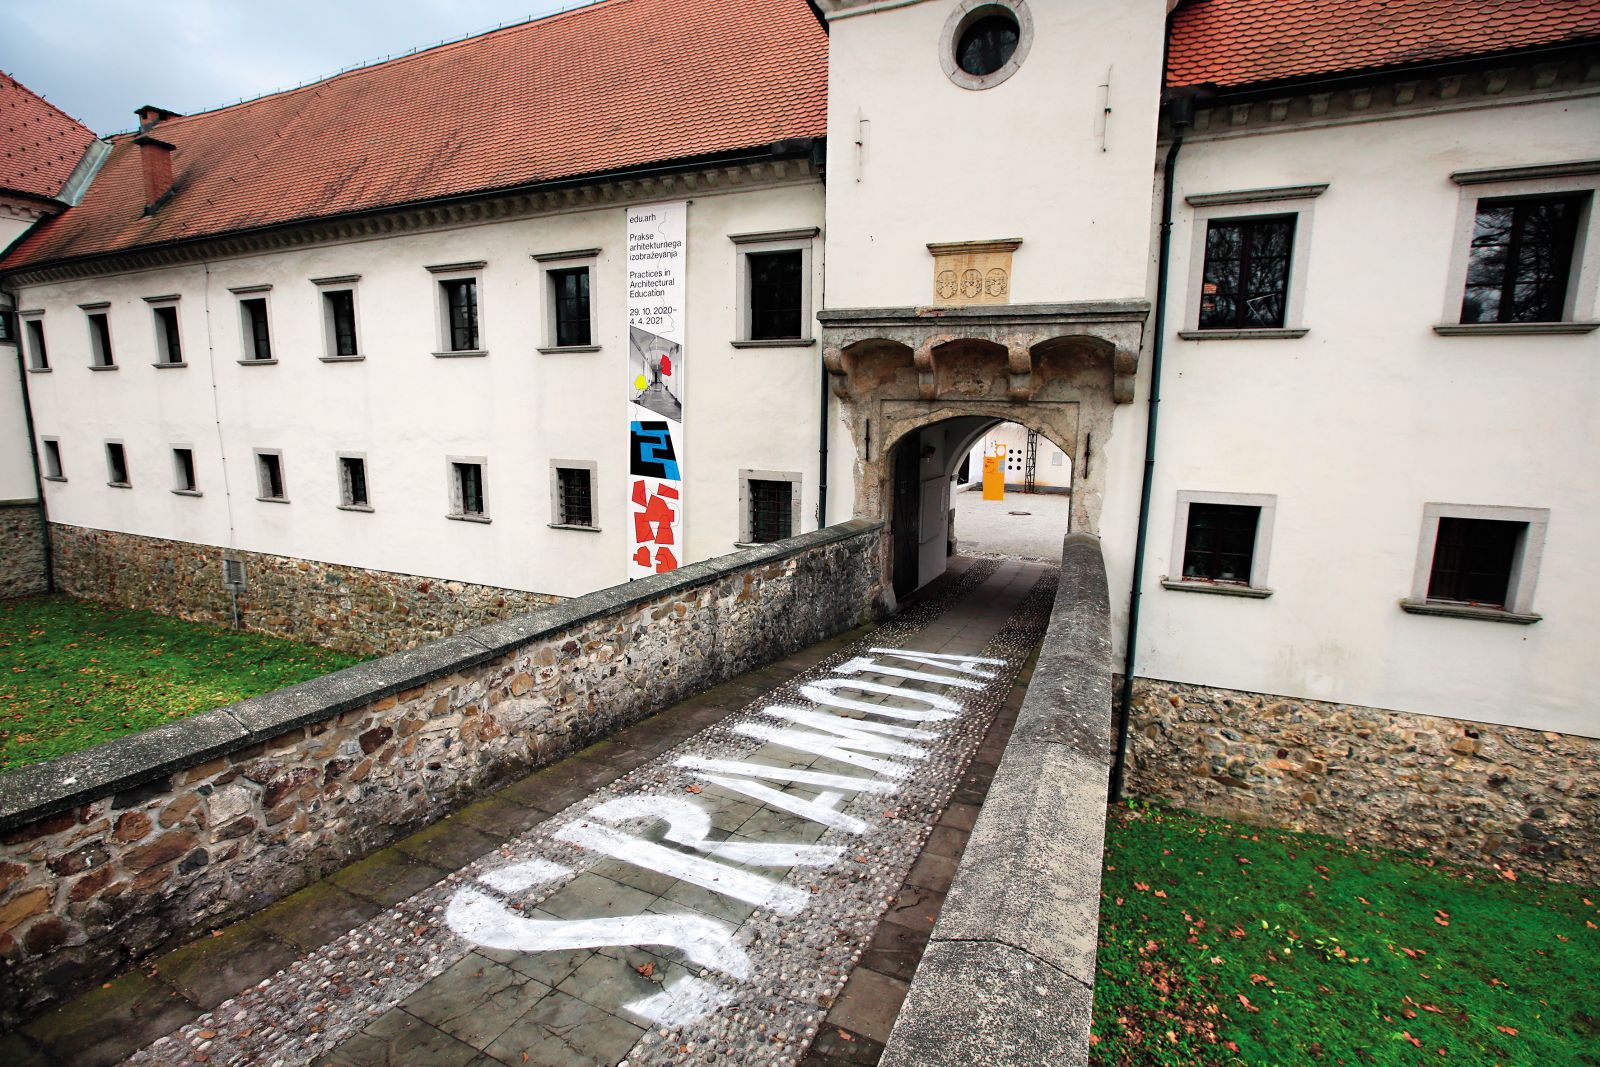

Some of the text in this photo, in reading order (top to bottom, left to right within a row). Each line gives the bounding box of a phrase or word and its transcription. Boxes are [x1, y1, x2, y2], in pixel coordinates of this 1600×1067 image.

[630, 213, 657, 224] edu.arh
[629, 233, 654, 242] Prakse
[630, 240, 682, 252] arhitekturnega
[629, 250, 678, 261] izobraževanja
[630, 269, 671, 279] Practices in
[630, 278, 675, 288] Architectural
[630, 289, 665, 298] Education
[630, 308, 641, 316] 29.
[642, 308, 652, 316] 10.
[630, 316, 663, 326] 4. 4. 2021
[445, 647, 1008, 1026] SRAMOTA
